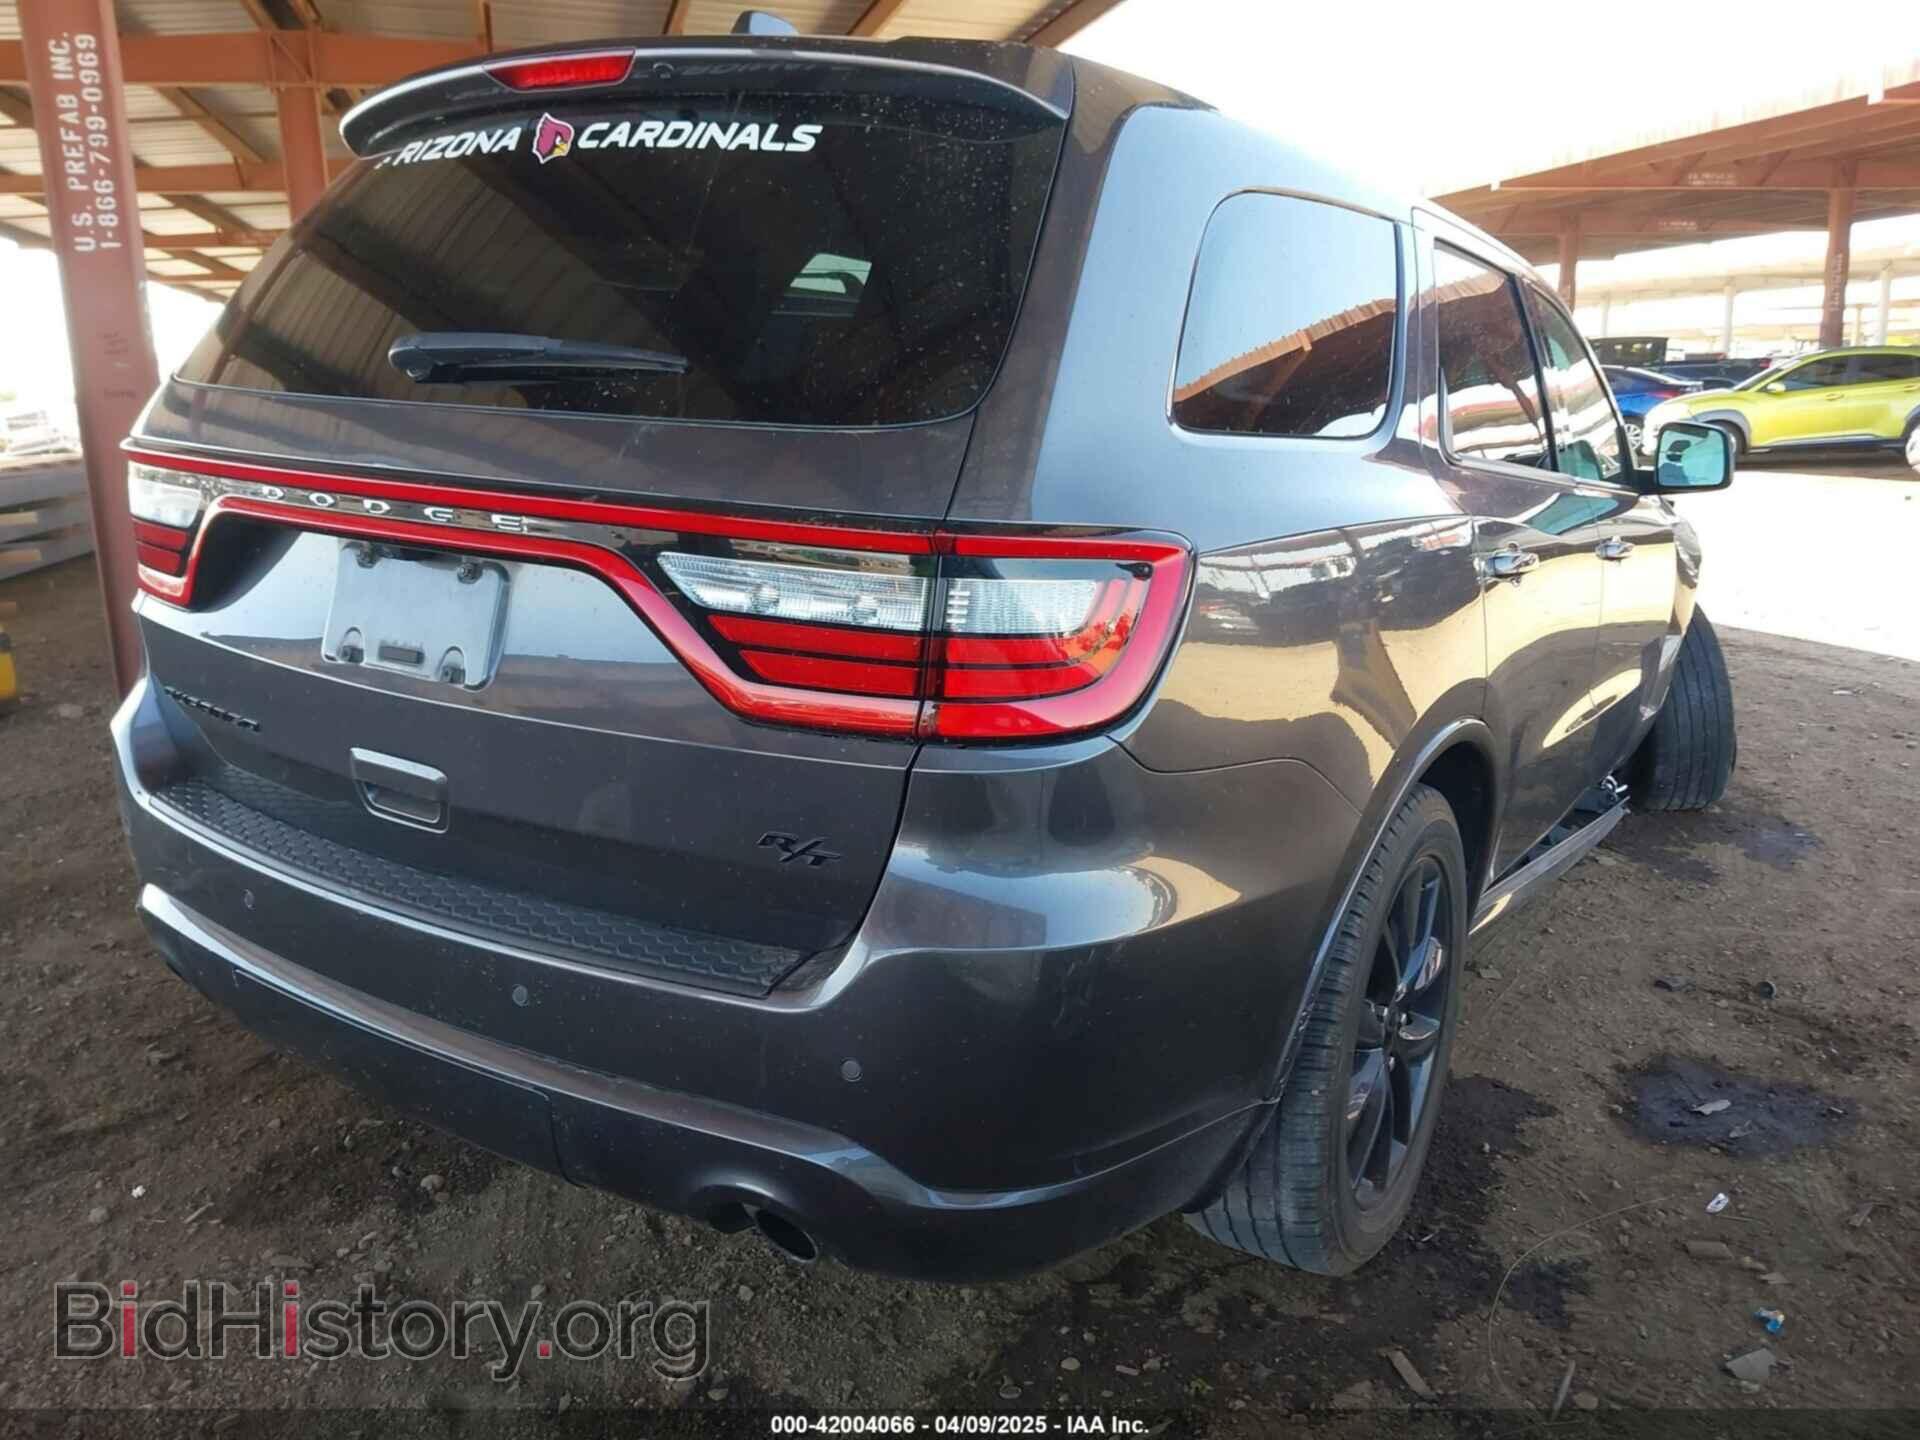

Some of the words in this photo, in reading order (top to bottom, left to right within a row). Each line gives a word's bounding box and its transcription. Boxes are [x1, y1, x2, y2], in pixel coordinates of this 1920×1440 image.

[49, 31, 74, 80] INC.
[57, 94, 89, 191] PREFAB
[75, 34, 121, 249] 1-866-799-0969
[577, 121, 823, 152] CARDINALS
[72, 205, 97, 252] U.S.
[261, 484, 523, 532] DODGE
[755, 831, 841, 868] R/T
